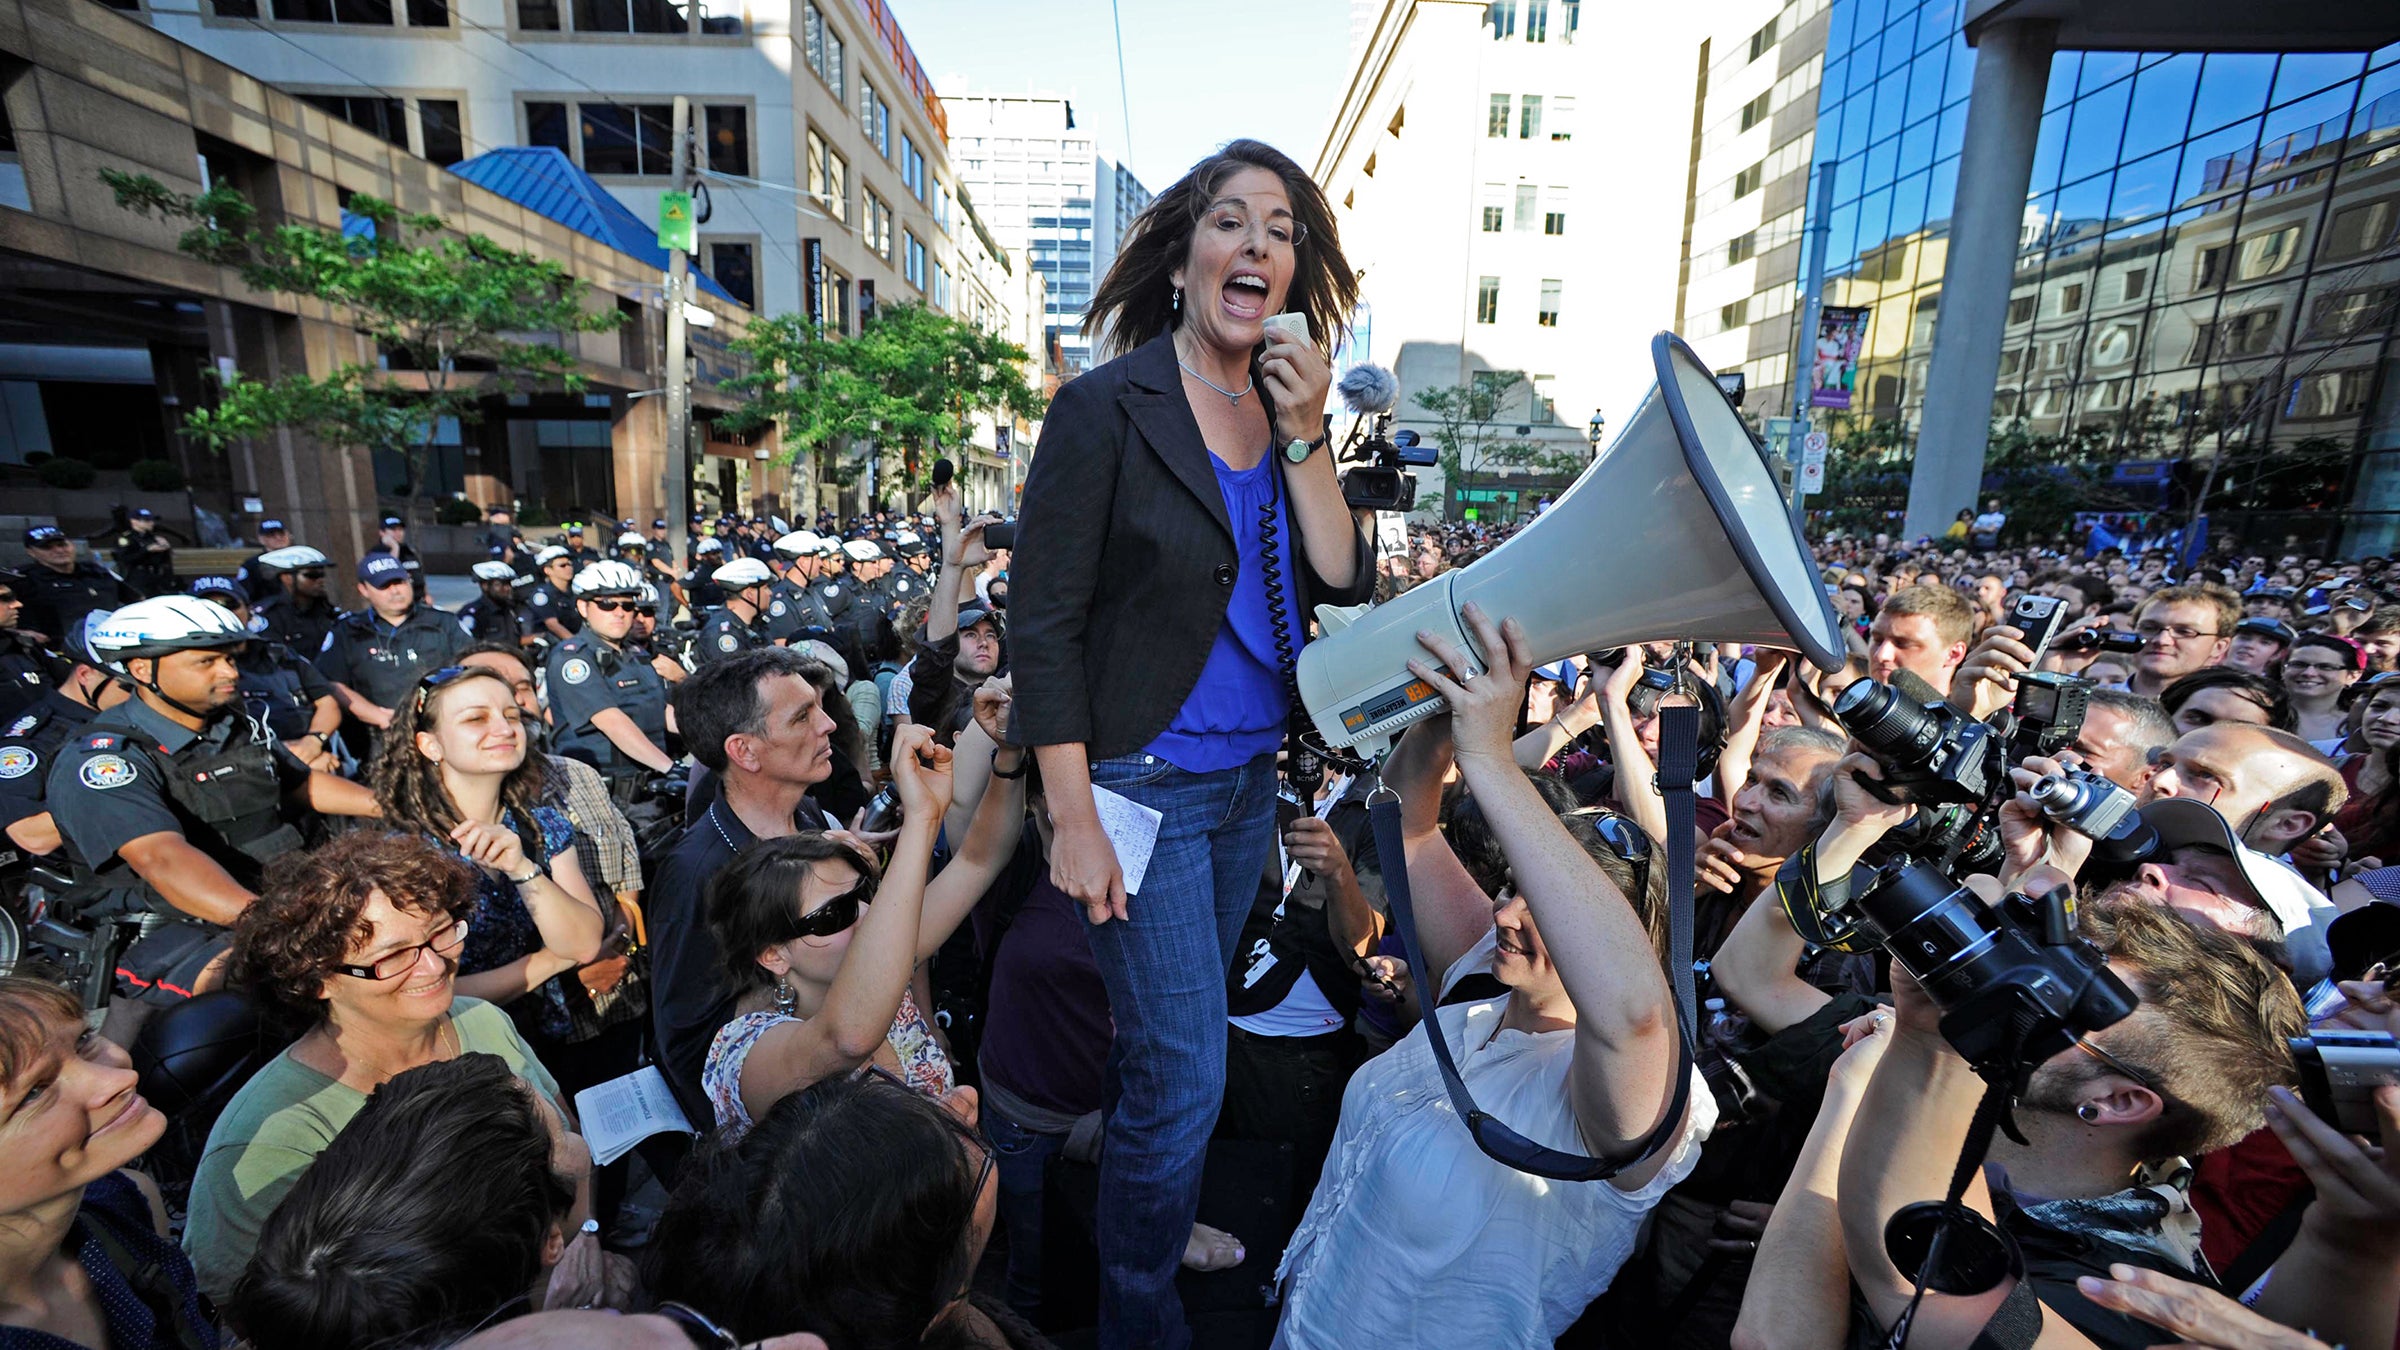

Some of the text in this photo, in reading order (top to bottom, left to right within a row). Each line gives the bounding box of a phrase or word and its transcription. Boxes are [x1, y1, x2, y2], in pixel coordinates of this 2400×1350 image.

[367, 558, 399, 574] POLICE
[1369, 697, 1407, 720] MEGAPHONE
[1921, 940, 1937, 955] G
